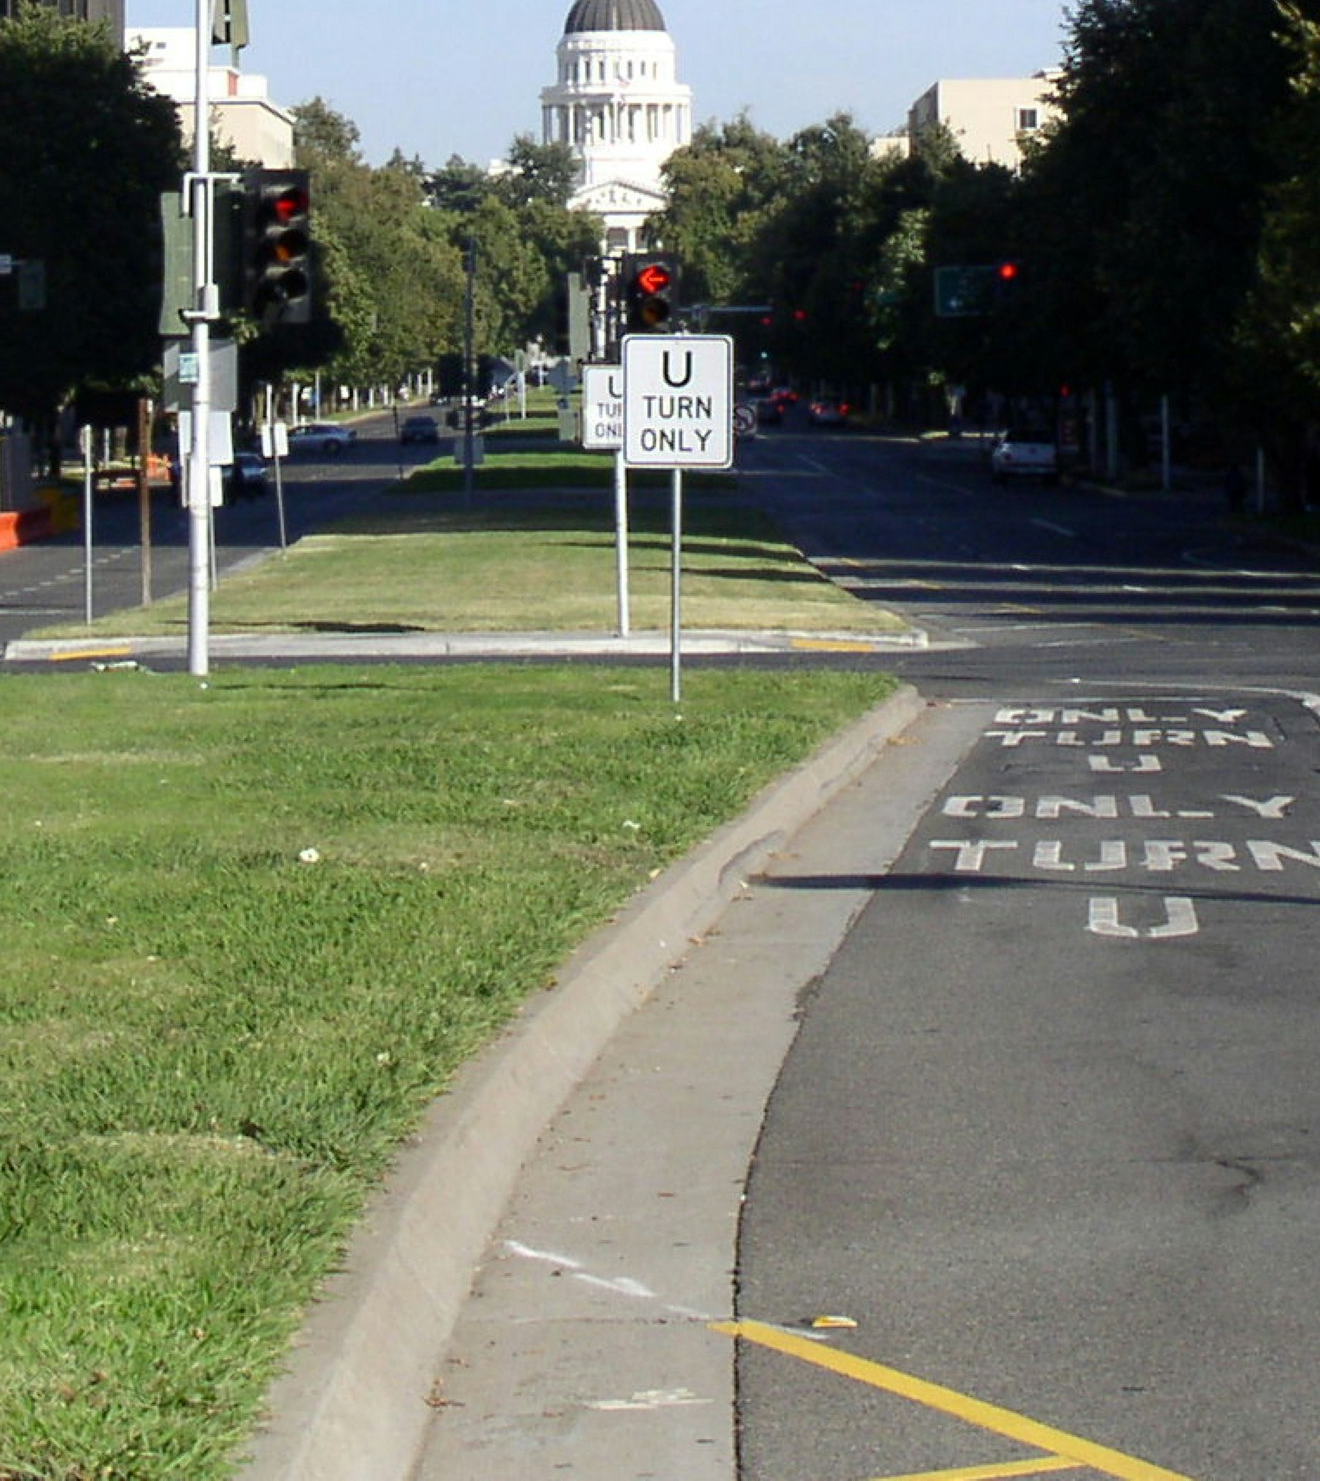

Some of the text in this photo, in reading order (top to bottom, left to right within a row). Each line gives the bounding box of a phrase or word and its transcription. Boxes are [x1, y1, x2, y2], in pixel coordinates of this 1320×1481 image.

[662, 351, 692, 388] U
[643, 396, 712, 419] TURN
[640, 428, 712, 452] ONLY
[994, 708, 1248, 724] ONLY
[984, 729, 1274, 748] TURN
[1088, 754, 1162, 772] U
[941, 794, 1297, 819] ONLY
[1086, 896, 1200, 938] U
